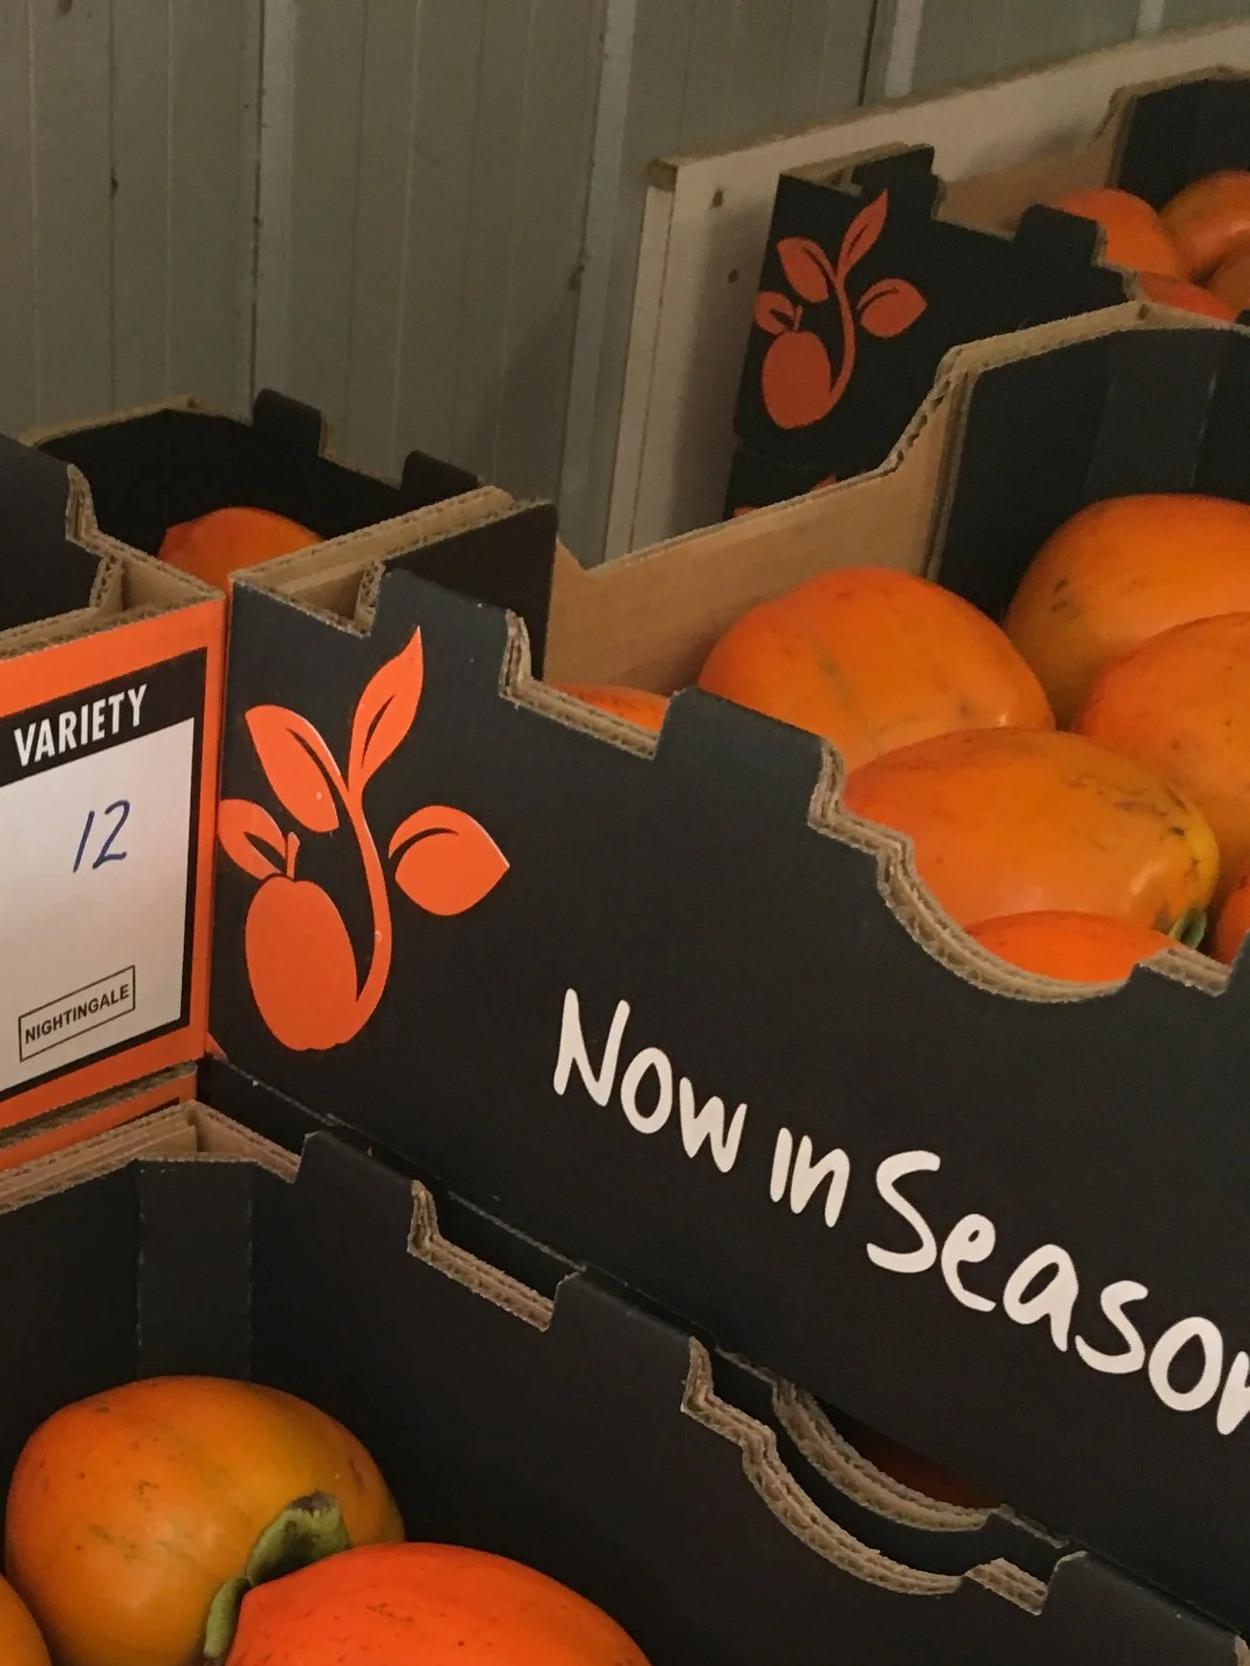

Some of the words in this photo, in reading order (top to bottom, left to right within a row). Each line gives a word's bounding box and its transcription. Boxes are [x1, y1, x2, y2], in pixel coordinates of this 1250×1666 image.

[13, 683, 148, 767] VARIETY
[71, 798, 131, 875] 12
[24, 983, 130, 1046] NIGHTINGALE
[552, 987, 748, 1174] Now
